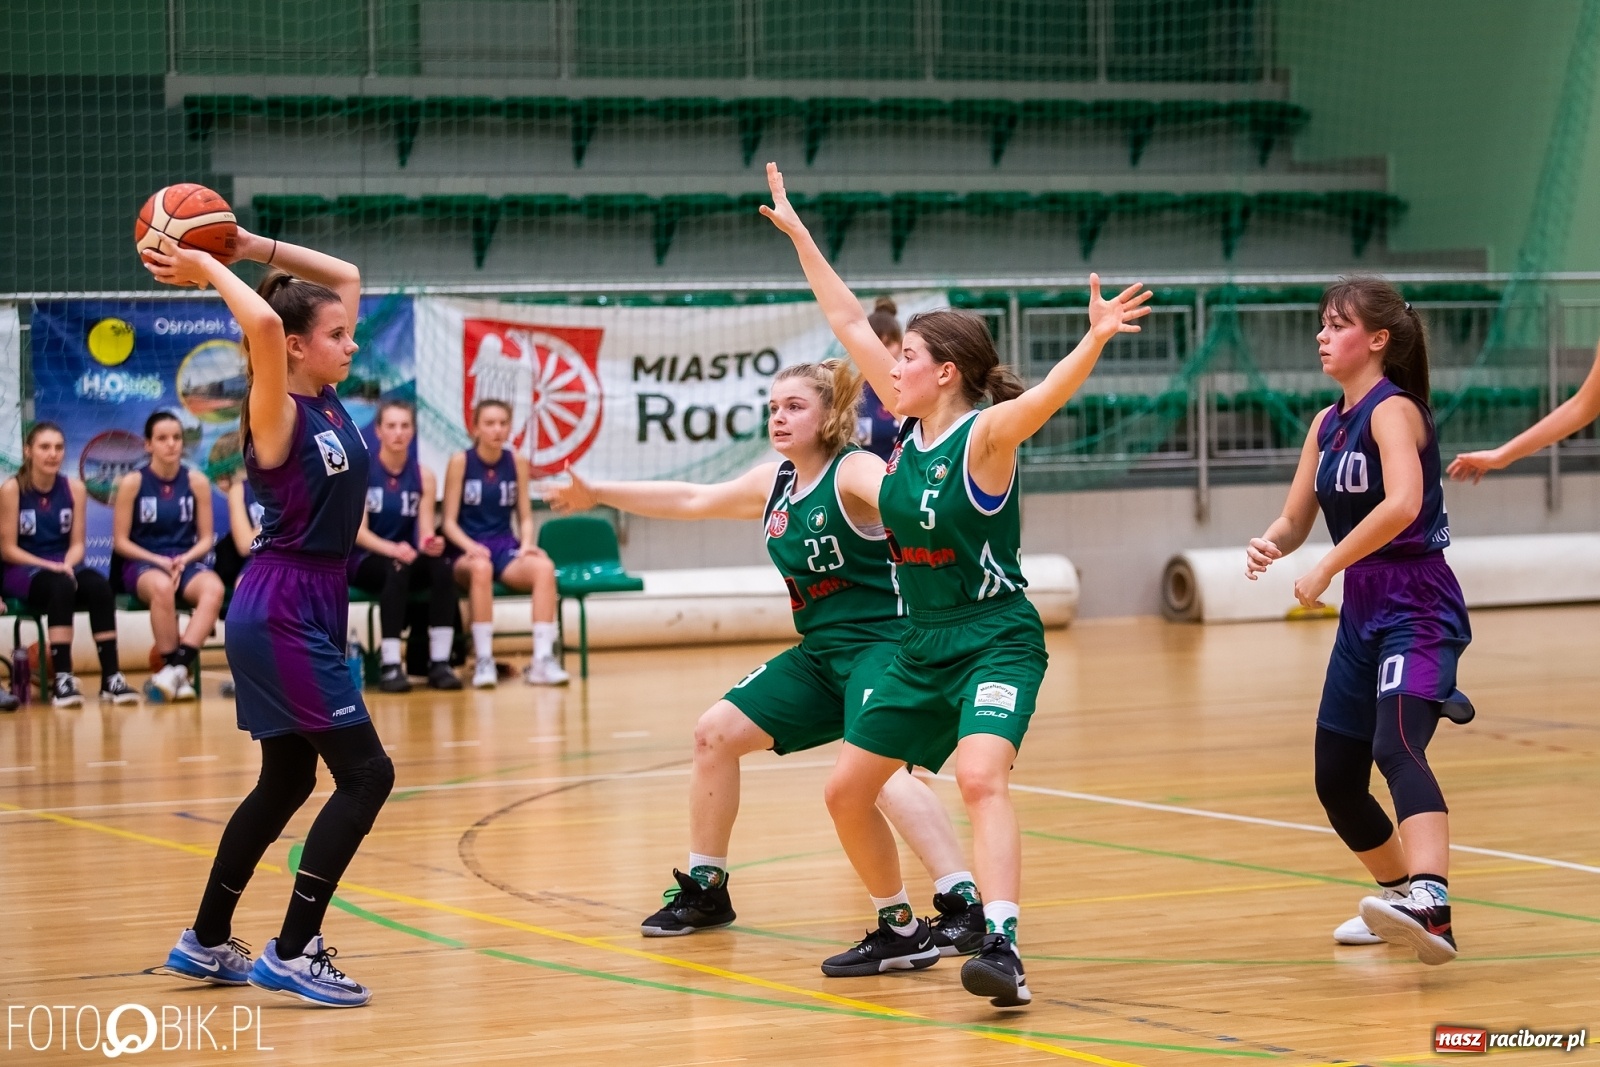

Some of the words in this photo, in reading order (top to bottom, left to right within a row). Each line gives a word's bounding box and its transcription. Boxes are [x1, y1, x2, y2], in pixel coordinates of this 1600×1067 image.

[632, 347, 781, 383] MIASTO
[636, 387, 770, 443] Raci
[1334, 451, 1370, 493] 10
[178, 496, 194, 523] 11
[919, 489, 940, 530] 5
[803, 535, 845, 573] 23
[335, 704, 356, 717] PROTON
[975, 710, 1009, 719] COLO
